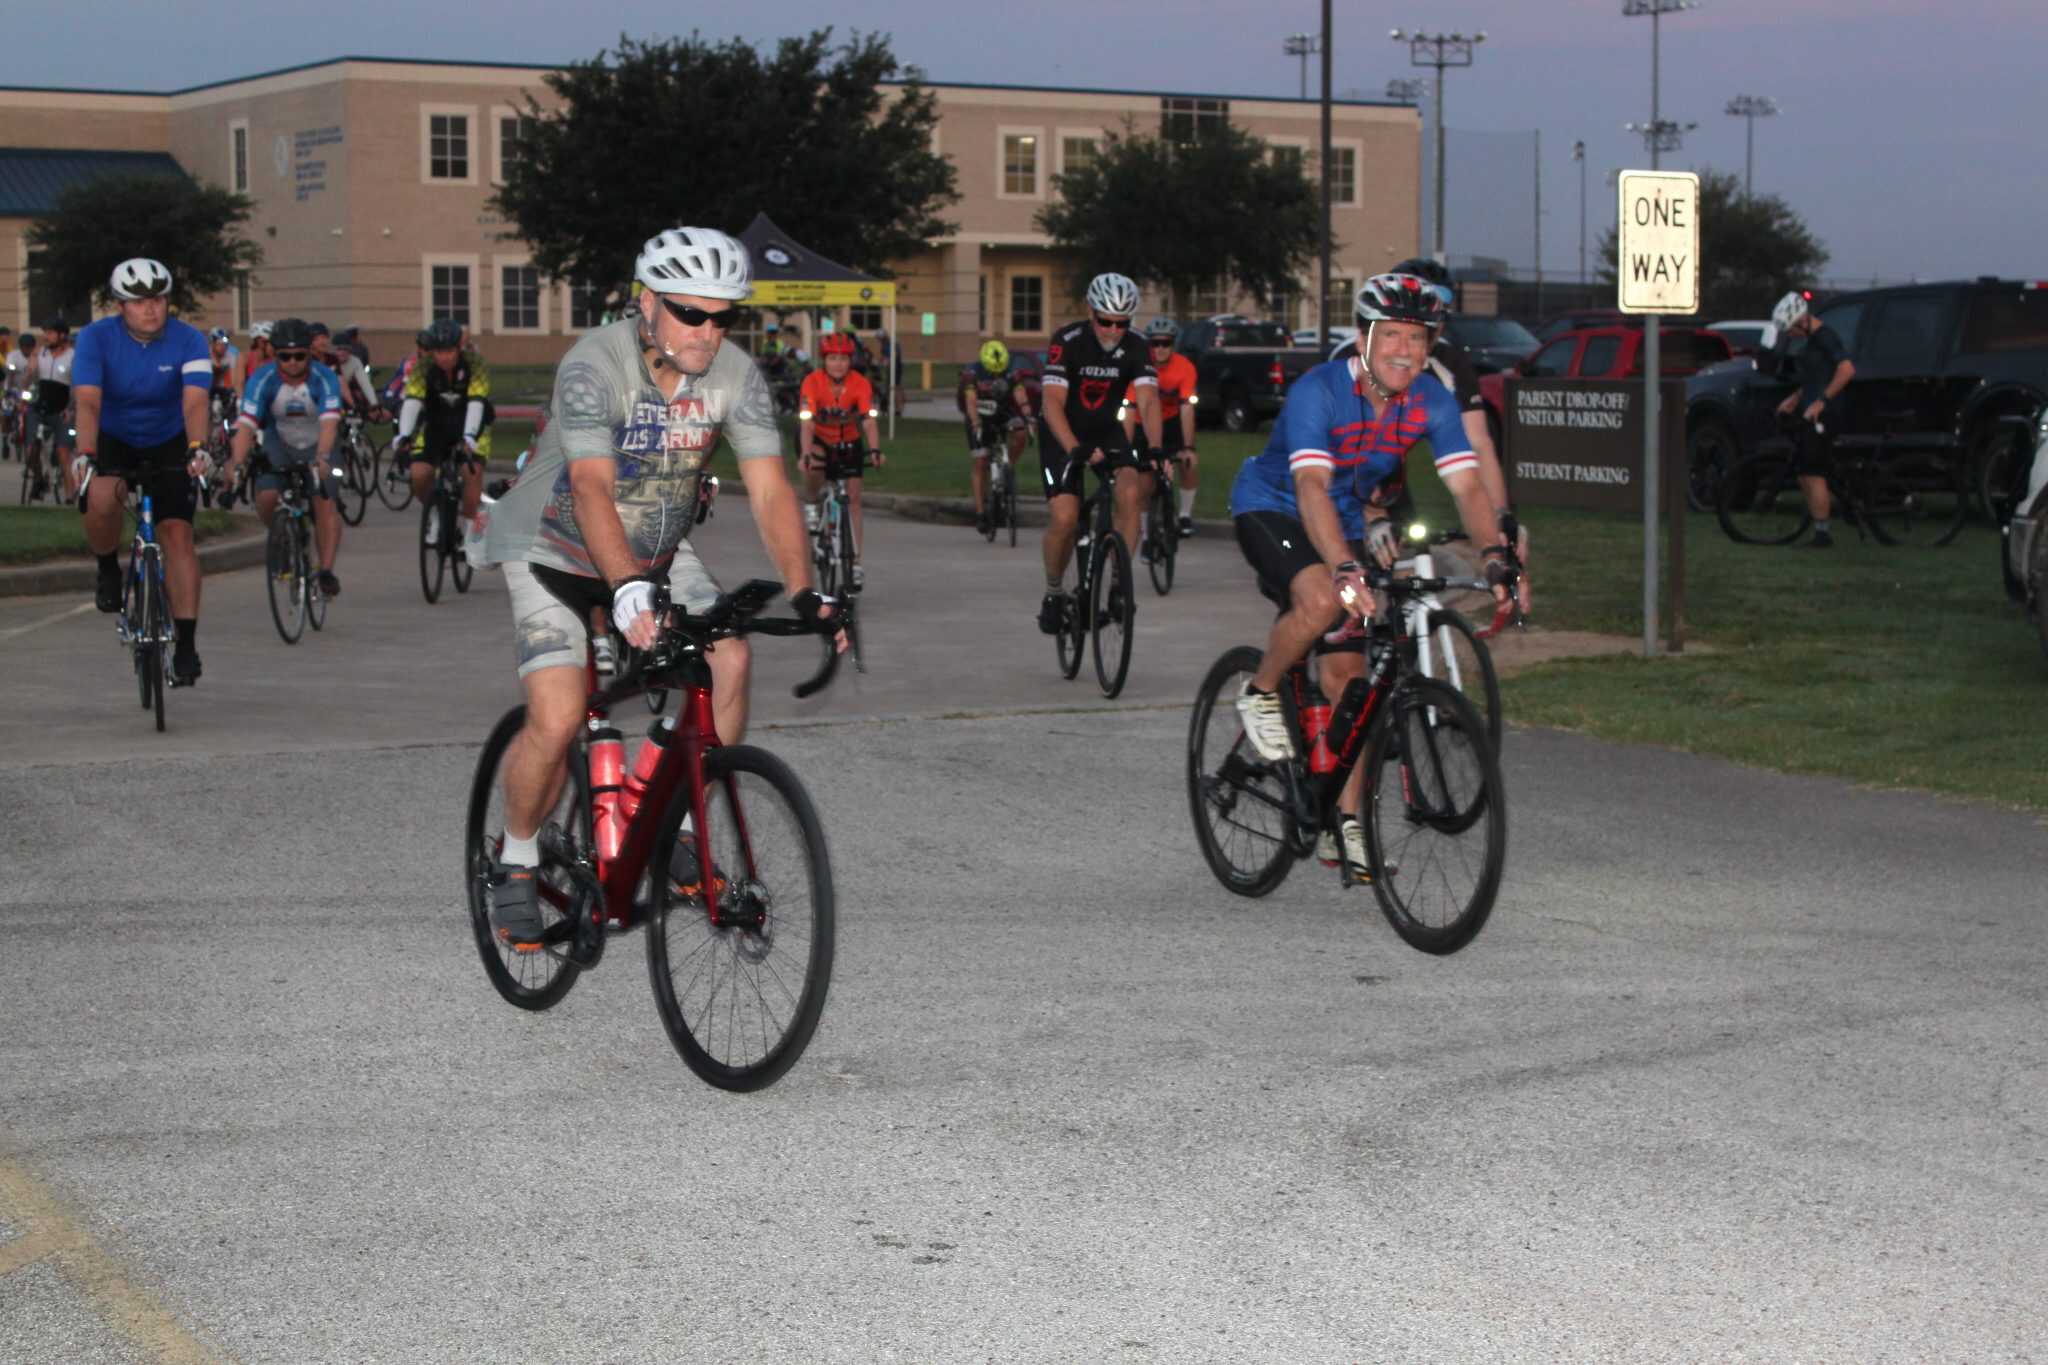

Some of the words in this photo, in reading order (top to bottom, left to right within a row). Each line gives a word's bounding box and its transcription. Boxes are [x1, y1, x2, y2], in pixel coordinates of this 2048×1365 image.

[1635, 197, 1686, 228] ONE
[1632, 253, 1686, 283] WAY
[621, 389, 725, 428] VETERAN
[1517, 390, 1563, 408] PARENT
[1517, 408, 1565, 426] VISITOR
[1567, 410, 1623, 429] PARKING
[621, 428, 649, 450] US
[1516, 462, 1571, 481] STUDENT
[1573, 465, 1630, 485] PARKING
